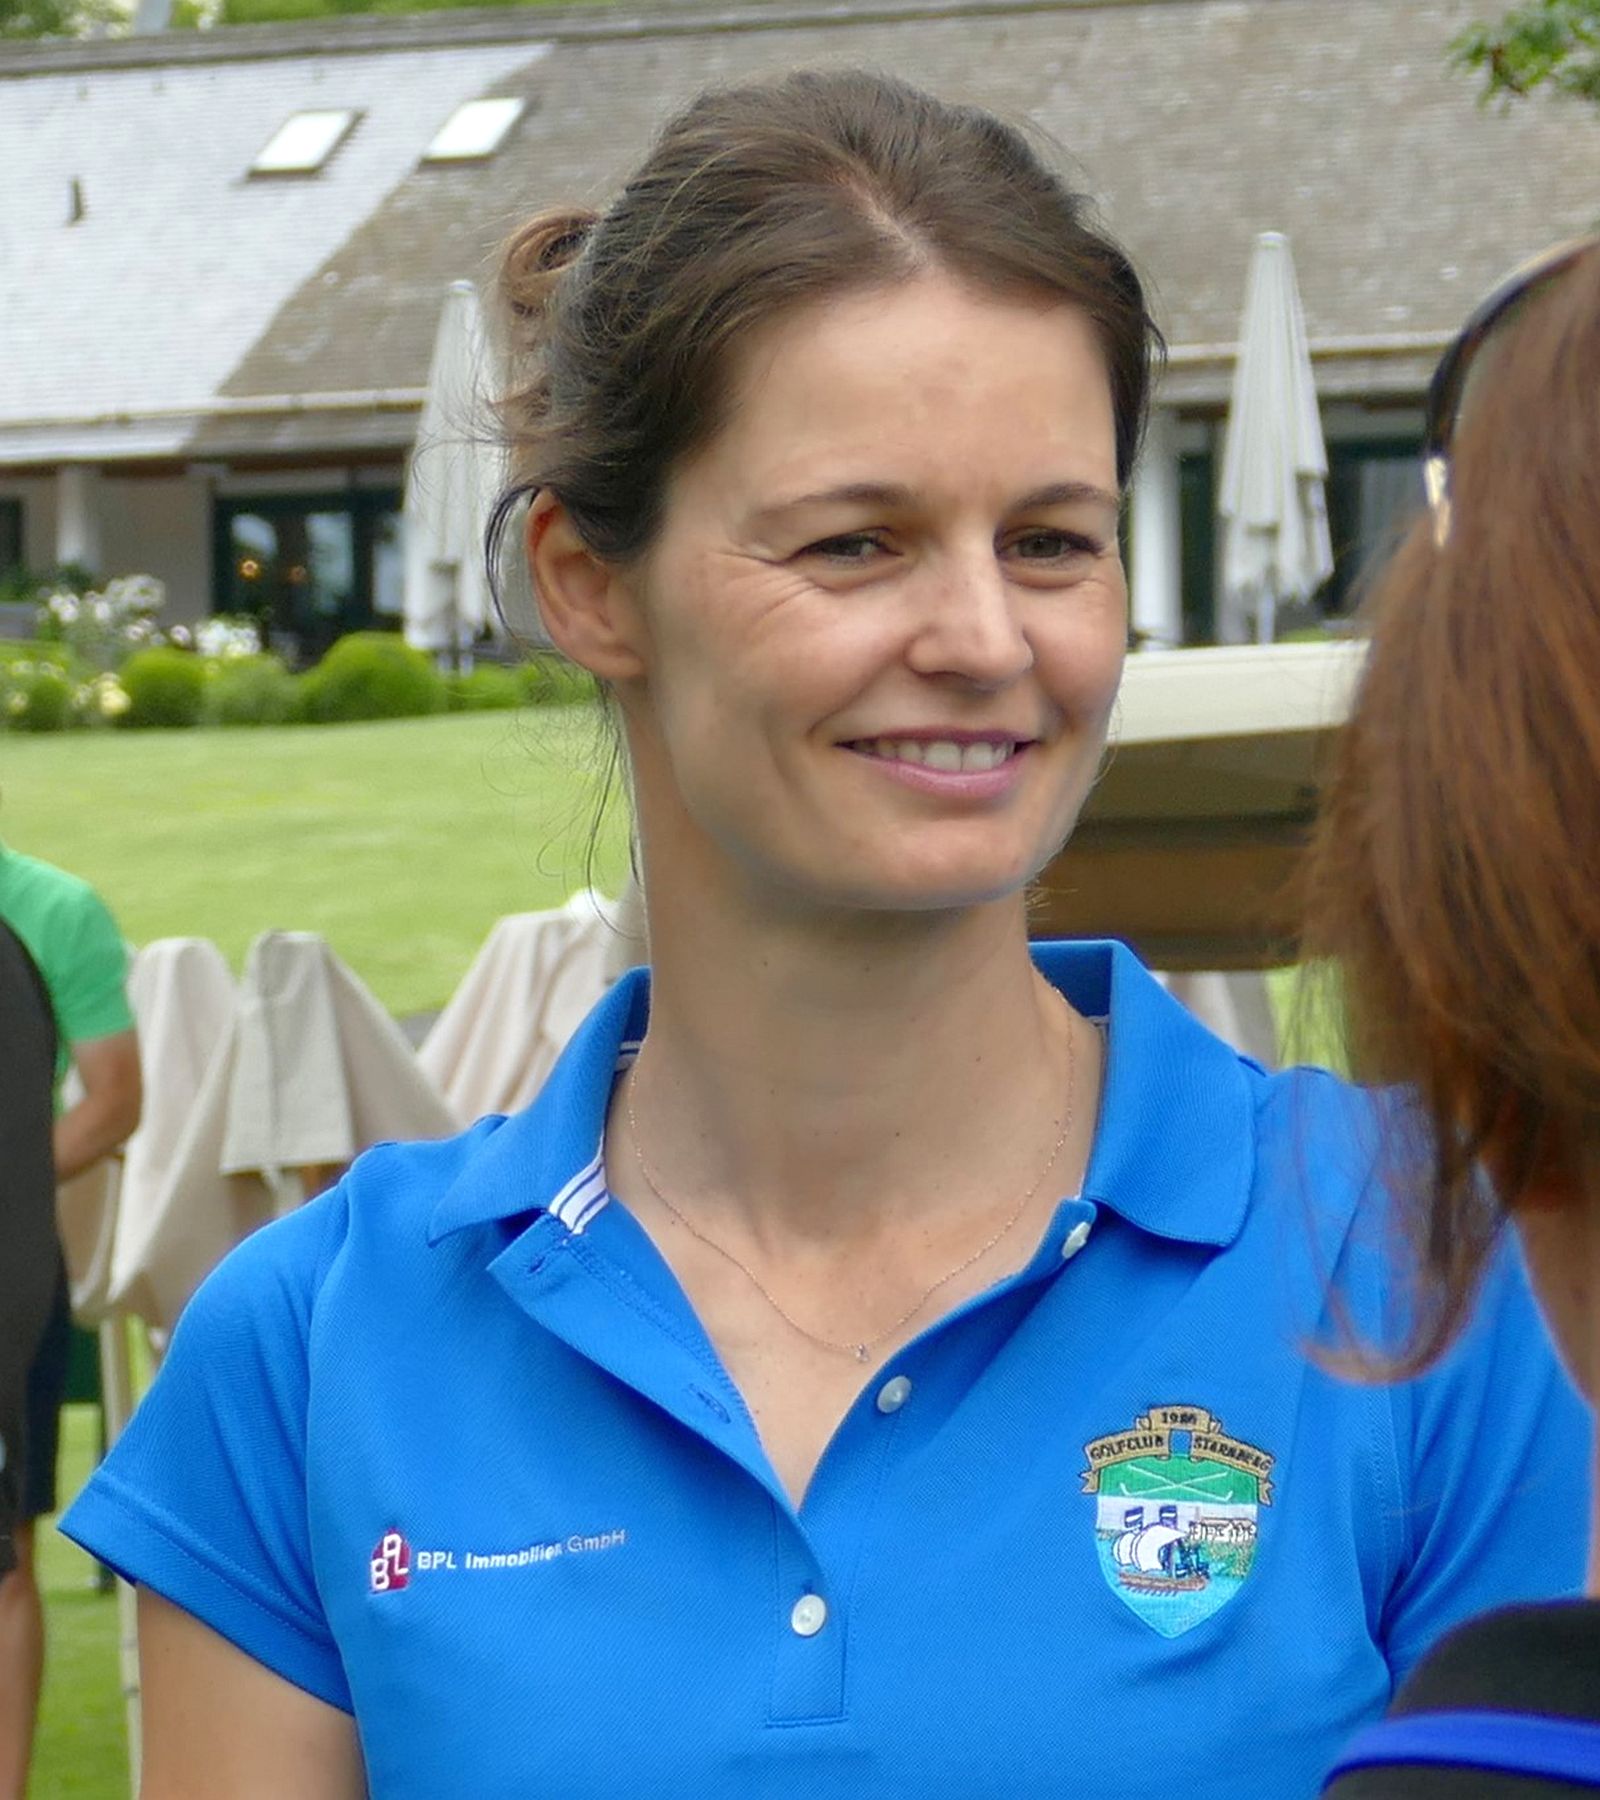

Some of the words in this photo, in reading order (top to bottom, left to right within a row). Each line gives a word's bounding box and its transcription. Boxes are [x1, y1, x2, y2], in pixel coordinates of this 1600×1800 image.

[1090, 1434, 1164, 1460] GOLFCLUB
[416, 1551, 457, 1570] BPL
[566, 1528, 626, 1553] GmbH
